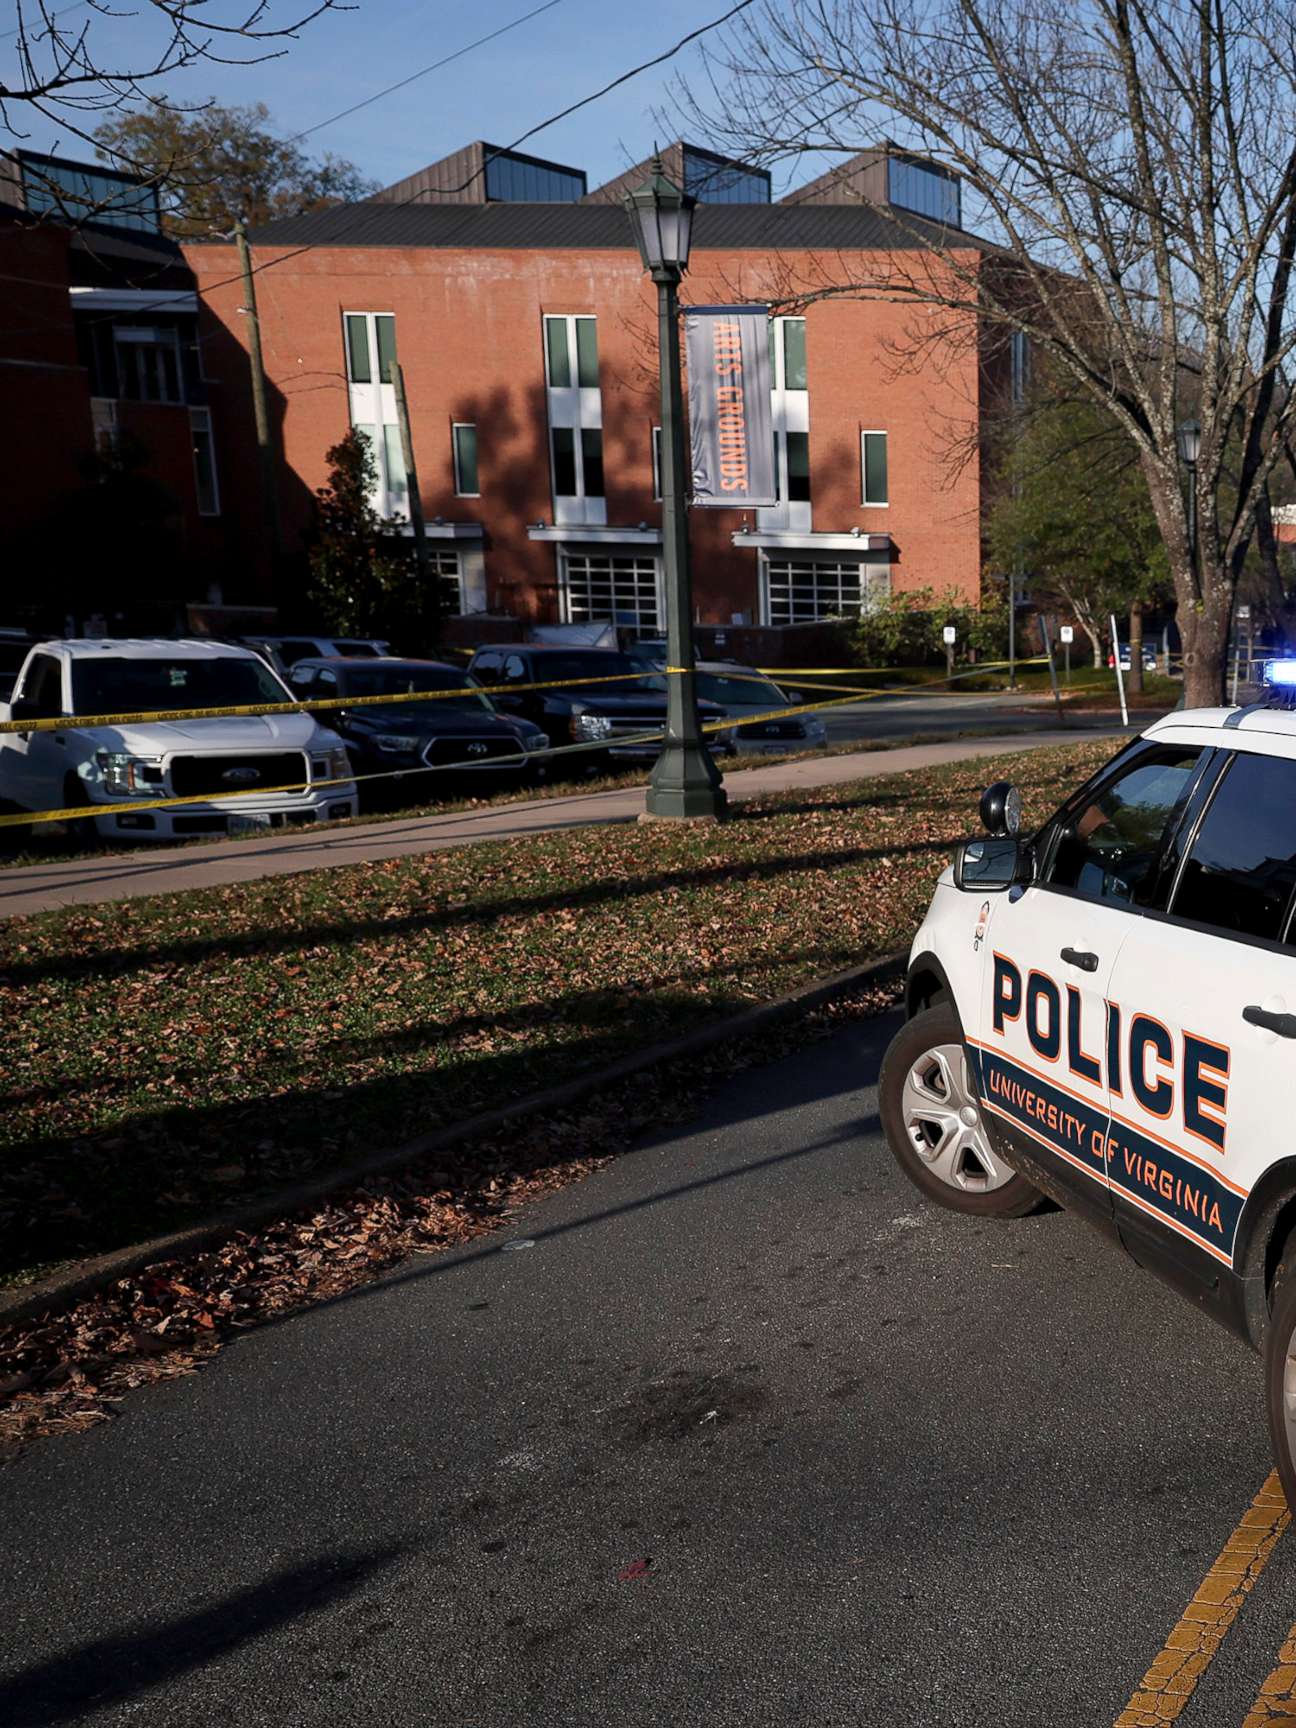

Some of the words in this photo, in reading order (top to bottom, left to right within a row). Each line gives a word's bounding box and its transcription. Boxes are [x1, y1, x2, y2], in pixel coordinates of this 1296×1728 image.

[714, 320, 743, 377] ARTS
[716, 385, 749, 492] GROUNDS
[993, 950, 1231, 1156] POLICE
[990, 1069, 1086, 1146] UNIVERSITY
[1091, 1130, 1119, 1163] OF
[1123, 1147, 1224, 1234] VIRGINIA
